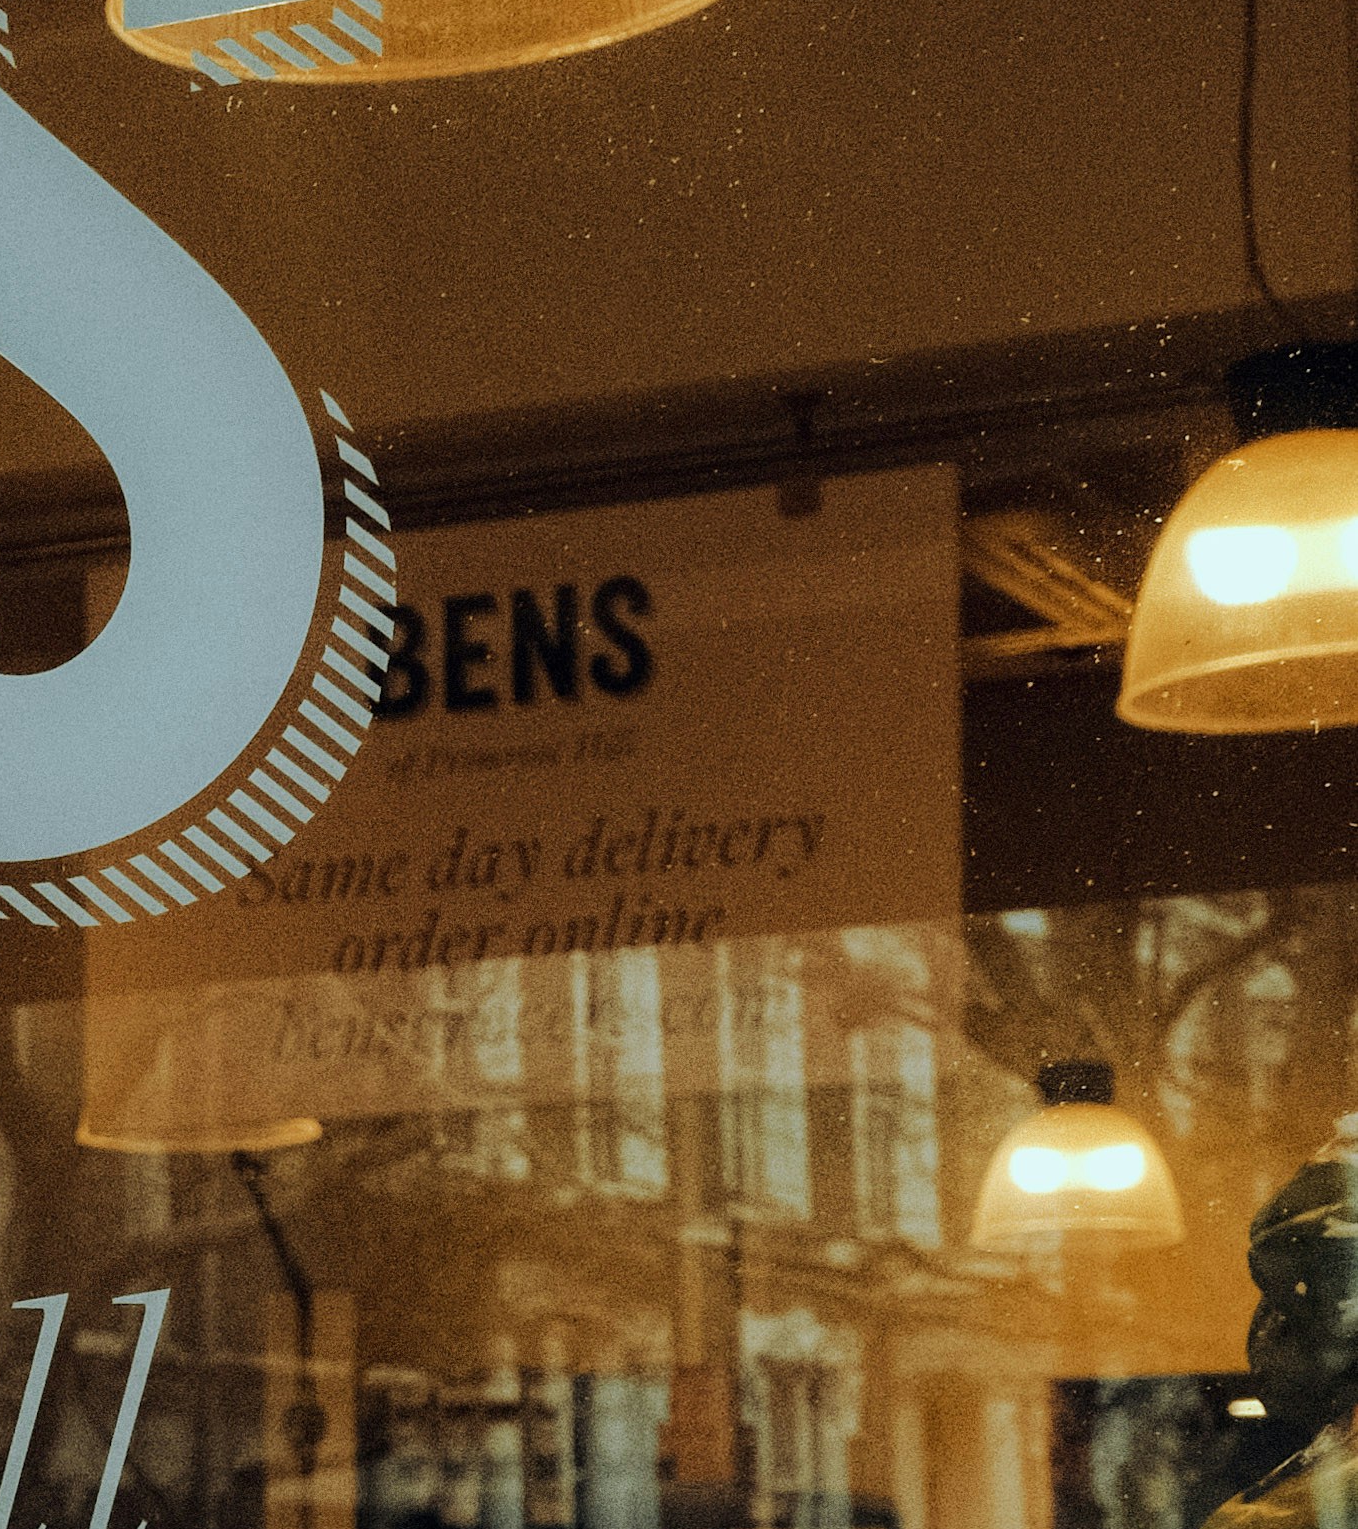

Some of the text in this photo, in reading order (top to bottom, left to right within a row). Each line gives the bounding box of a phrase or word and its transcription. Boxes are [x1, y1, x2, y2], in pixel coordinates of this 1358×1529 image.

[369, 574, 655, 720] BENS
[237, 807, 826, 908] Same day delivery
[333, 895, 728, 976] order online
